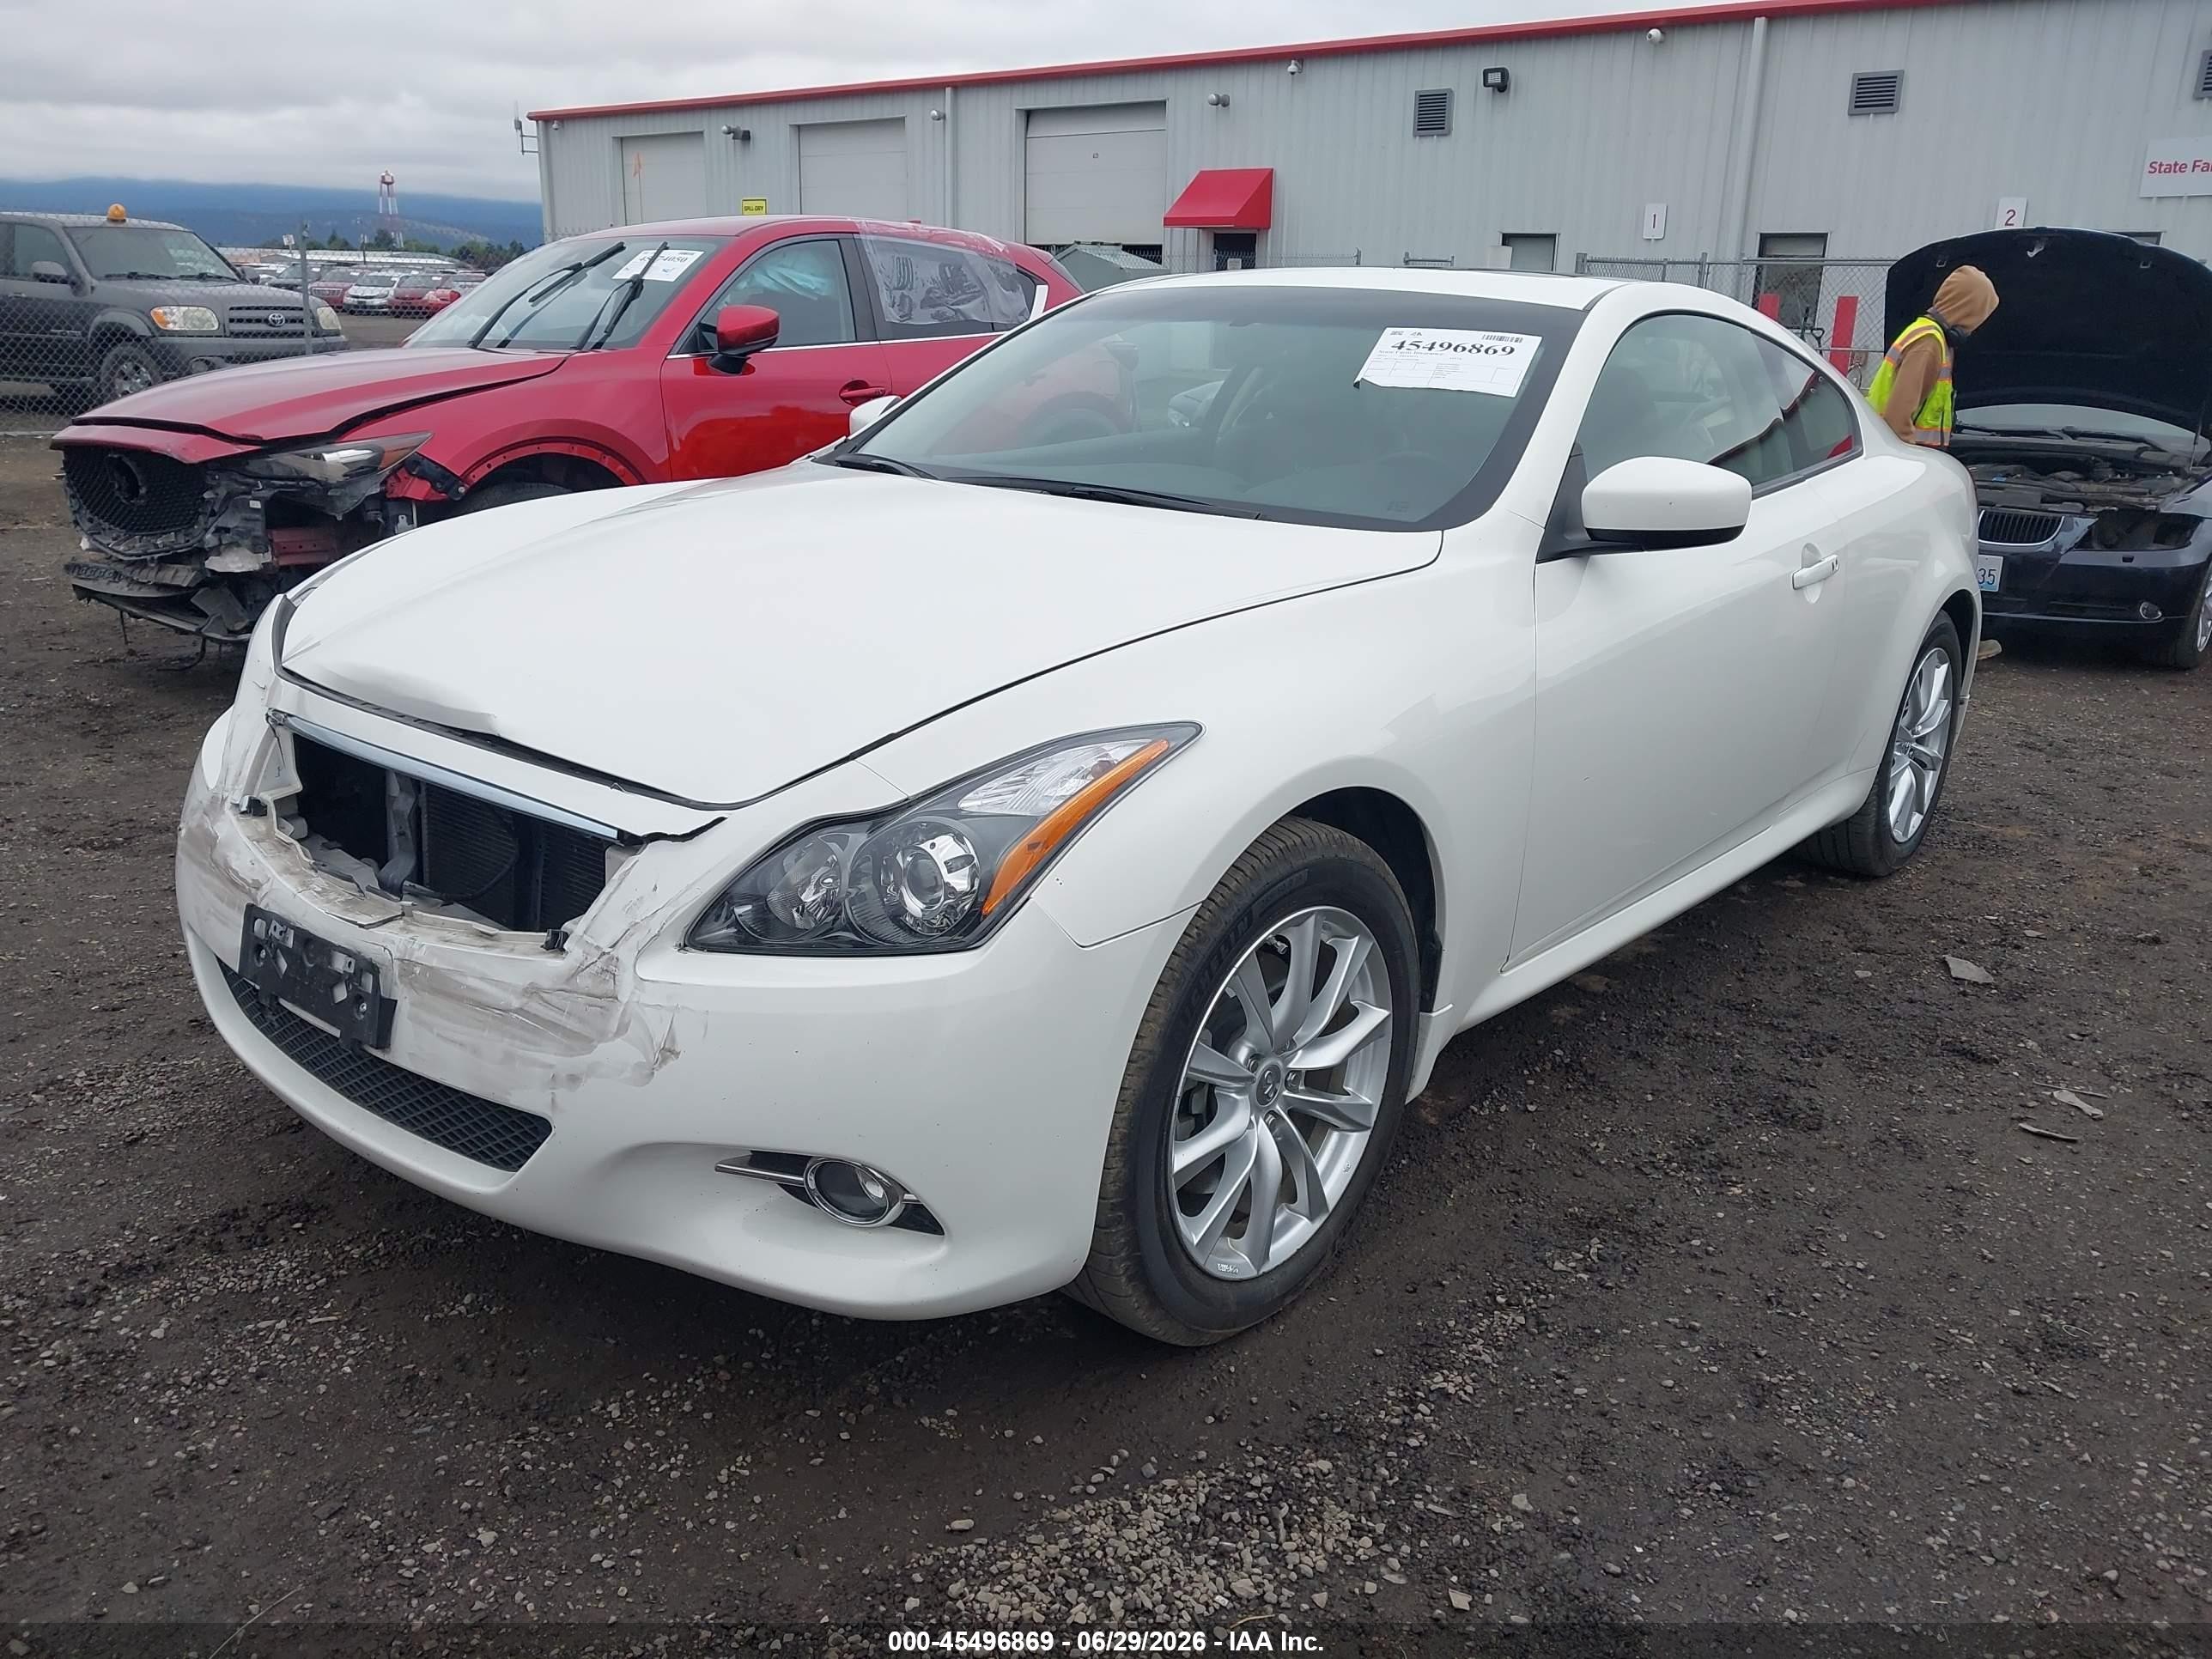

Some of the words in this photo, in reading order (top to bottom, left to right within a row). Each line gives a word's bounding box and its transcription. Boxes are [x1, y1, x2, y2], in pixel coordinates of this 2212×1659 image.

[2148, 160, 2188, 174] State
[2191, 159, 2212, 173] Fa
[1652, 214, 1656, 229] 1
[2004, 209, 2016, 227] 2
[1390, 339, 1516, 356] 45496869
